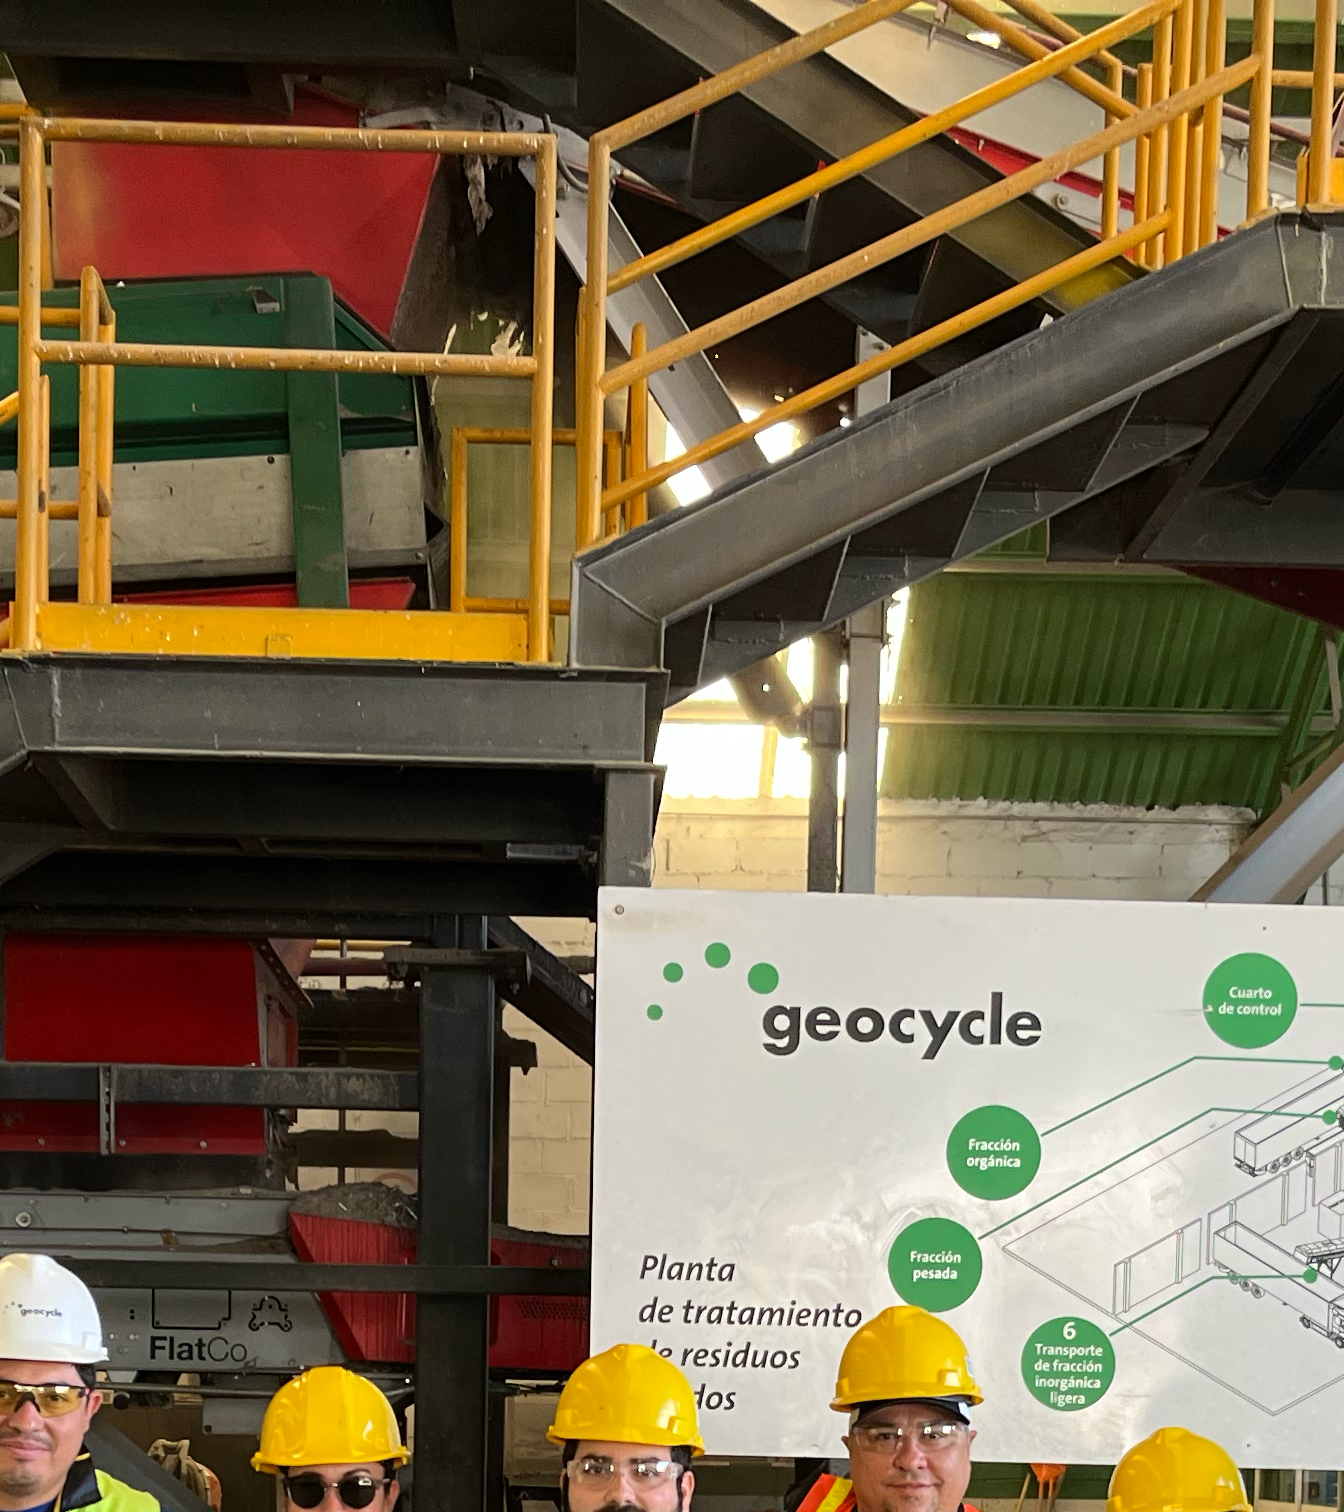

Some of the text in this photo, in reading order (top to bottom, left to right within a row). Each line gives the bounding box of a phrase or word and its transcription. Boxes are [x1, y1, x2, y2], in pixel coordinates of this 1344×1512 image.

[1229, 985, 1272, 999] Cuarto
[1218, 1001, 1282, 1016] de control
[762, 991, 1042, 1060] geocycle
[968, 1137, 1021, 1153] Fracción
[966, 1153, 1021, 1170] orgánica
[910, 1250, 962, 1266] Fracción
[639, 1253, 736, 1282] Planta
[912, 1266, 958, 1282] pesada
[20, 1308, 63, 1318] geocycle
[638, 1296, 862, 1328] de tratamiento
[1062, 1321, 1077, 1340] 6
[149, 1335, 248, 1363] FlatCo
[680, 1341, 801, 1369] residuos
[1034, 1343, 1103, 1361] Transporte
[1034, 1358, 1103, 1373] de fracción
[1034, 1374, 1102, 1391] inorgánica
[1049, 1391, 1086, 1407] ligera
